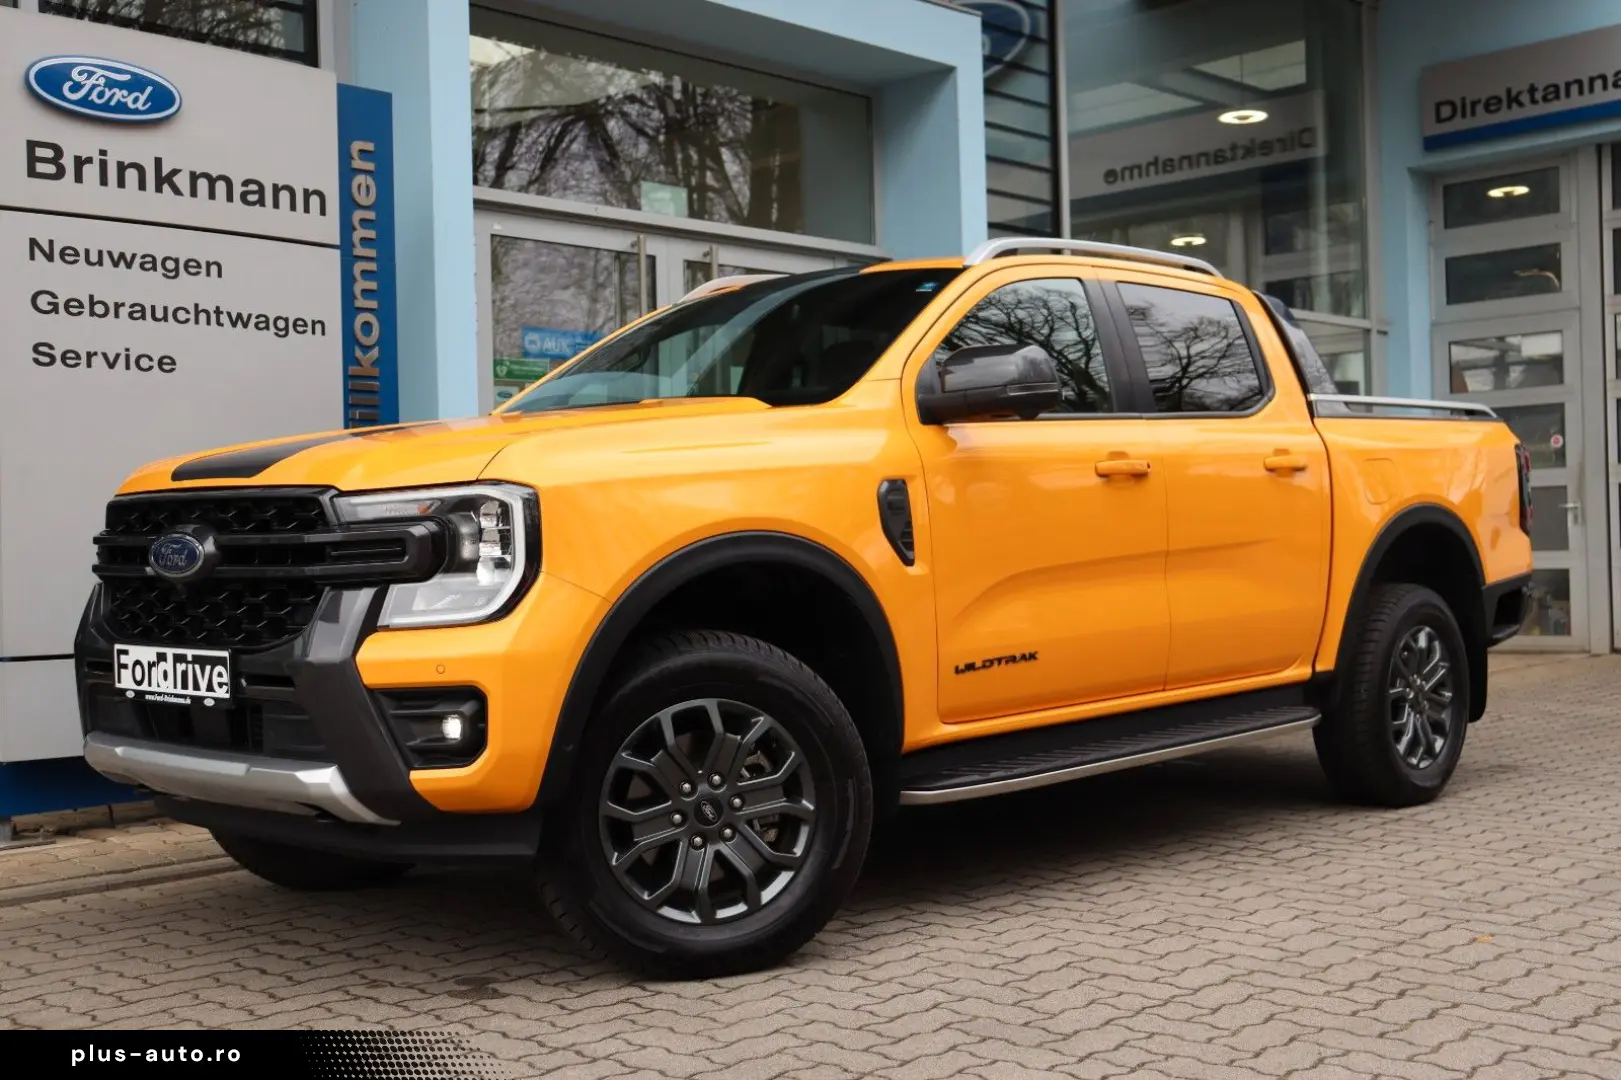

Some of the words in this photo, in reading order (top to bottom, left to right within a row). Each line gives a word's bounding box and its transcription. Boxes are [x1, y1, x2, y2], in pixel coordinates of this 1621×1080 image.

[62, 64, 154, 111] Ford
[25, 139, 328, 217] Brinkmann
[28, 237, 224, 280] Neuwagen
[29, 289, 327, 338] Gebrauchtwagen
[31, 341, 178, 374] Service
[158, 543, 188, 566] Ford
[115, 648, 229, 694] Fordrive
